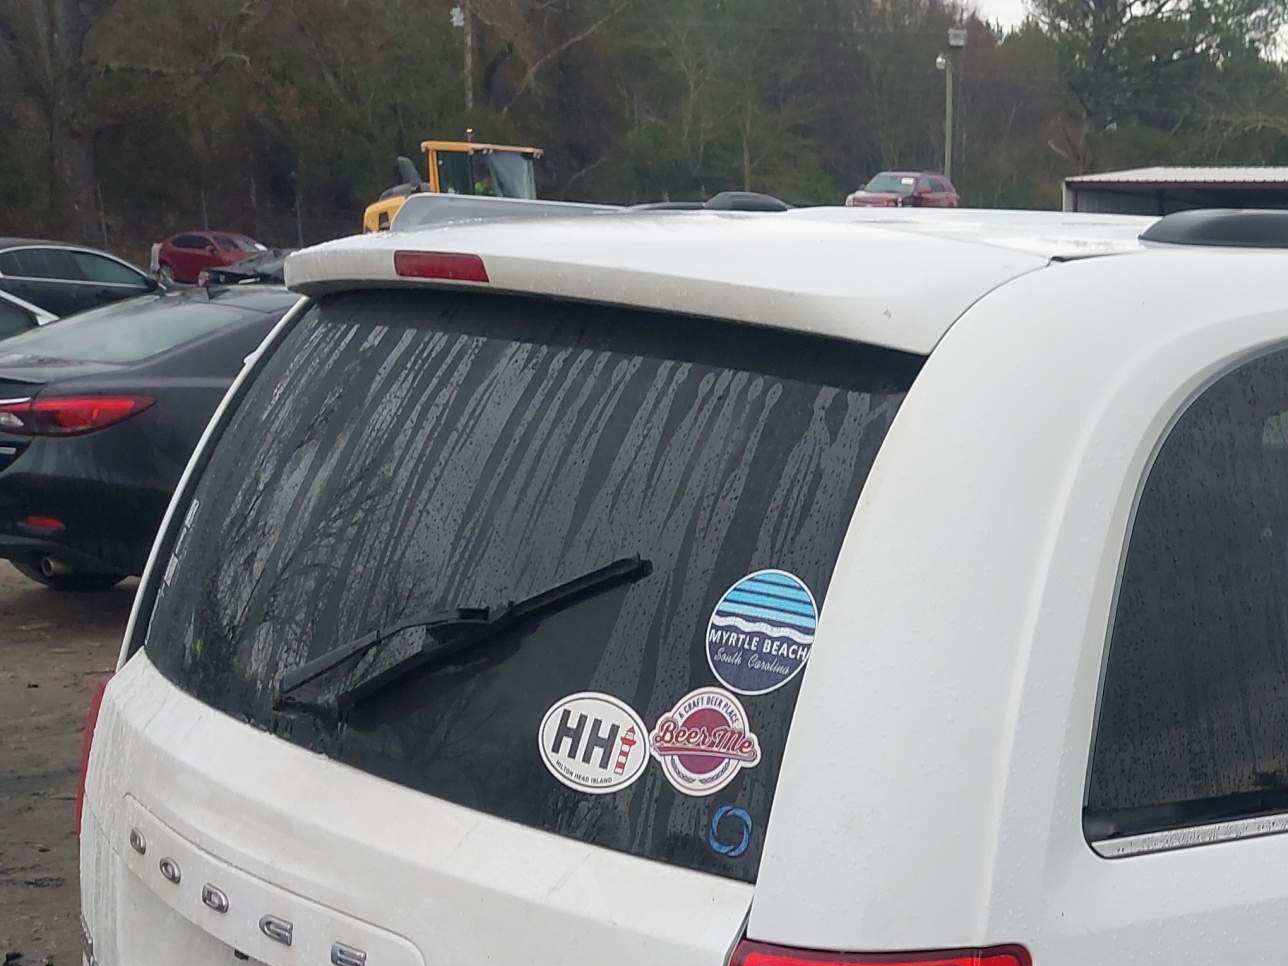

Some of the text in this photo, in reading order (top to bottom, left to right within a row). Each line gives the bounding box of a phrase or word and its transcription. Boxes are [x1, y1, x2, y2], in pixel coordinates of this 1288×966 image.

[709, 629, 808, 661] MYRTLE BEACH
[714, 646, 790, 675] South Carolina
[683, 696, 705, 713] CRAFT
[722, 702, 739, 724] PLACE
[655, 719, 755, 754] Beer Me
[556, 759, 613, 785] HILTON HEAD ISLAND
